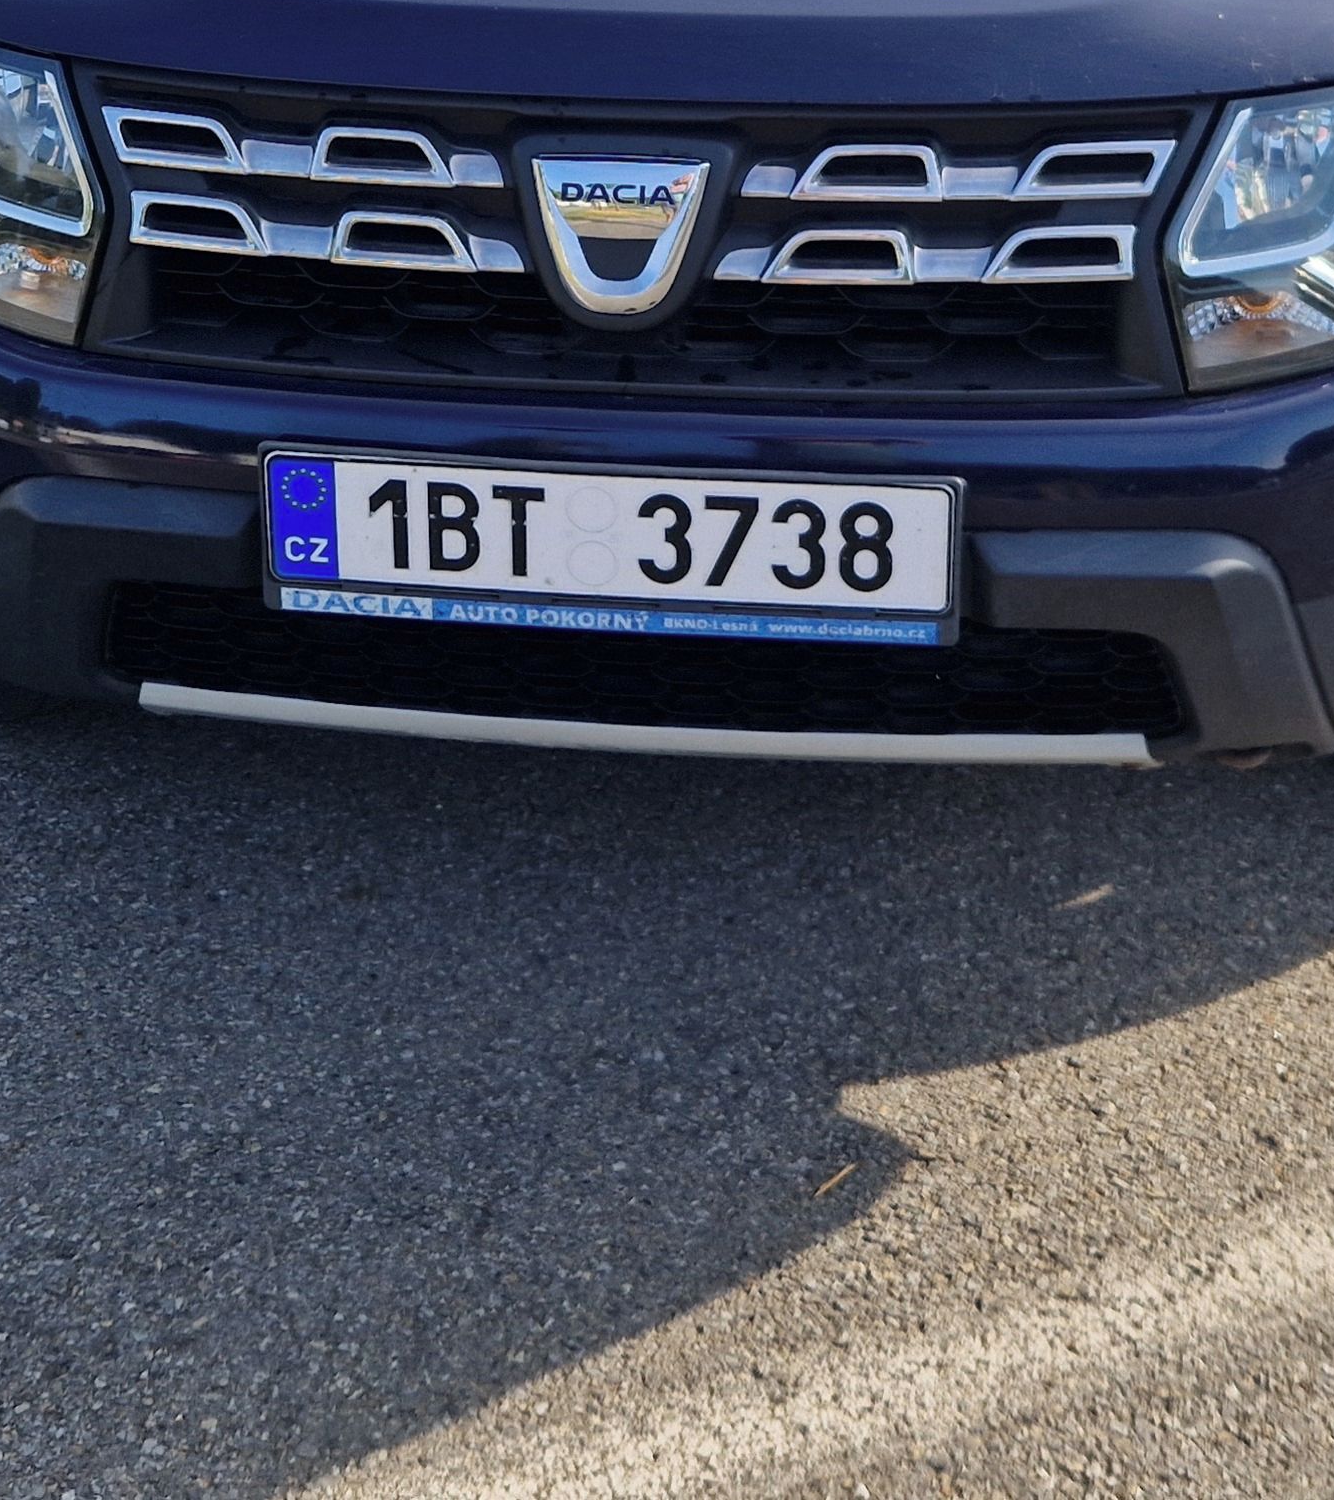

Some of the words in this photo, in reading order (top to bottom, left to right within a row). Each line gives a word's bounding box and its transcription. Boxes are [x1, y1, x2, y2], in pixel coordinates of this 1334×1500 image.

[560, 182, 675, 205] DACIA
[284, 535, 330, 564] CZ
[368, 479, 546, 577] 1BT
[637, 494, 894, 592] 3738
[291, 590, 422, 617] DACIA
[449, 603, 519, 622] AUTO
[526, 609, 649, 631] POKORNÝ
